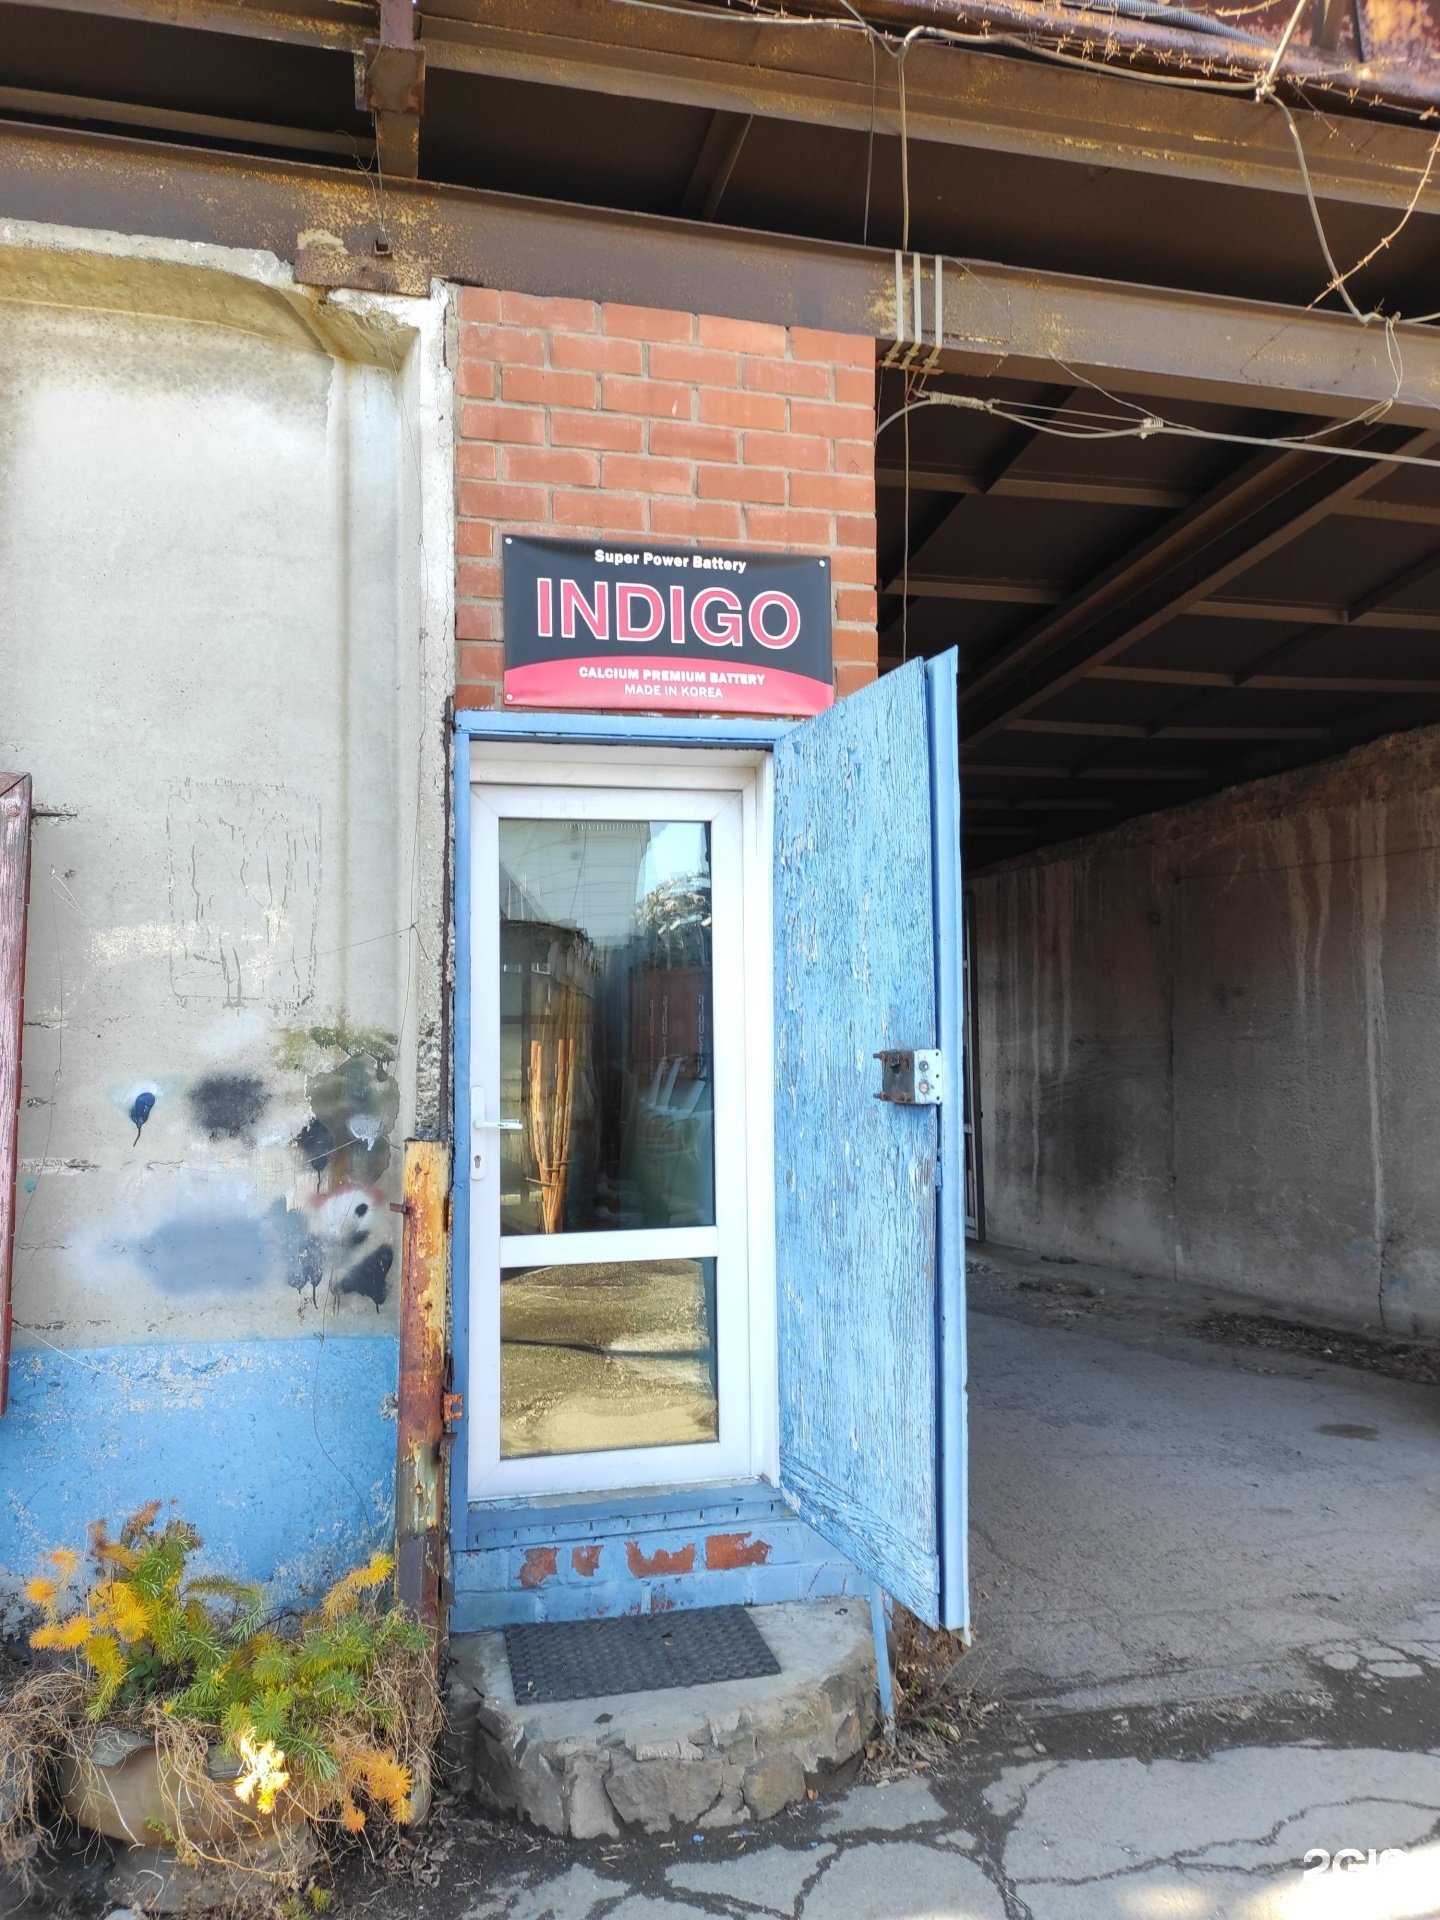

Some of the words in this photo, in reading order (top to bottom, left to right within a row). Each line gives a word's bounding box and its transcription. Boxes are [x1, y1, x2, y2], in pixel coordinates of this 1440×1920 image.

[594, 549, 640, 566] Super
[643, 552, 690, 568] Power
[693, 555, 747, 574] Battery
[536, 577, 801, 650] INDIGO
[579, 667, 639, 681] CALCIUM
[643, 669, 706, 683] PREMIUM
[710, 672, 765, 686] BATTERY
[624, 684, 661, 696] MADE
[665, 686, 678, 697] IN
[681, 686, 723, 698] KOREA
